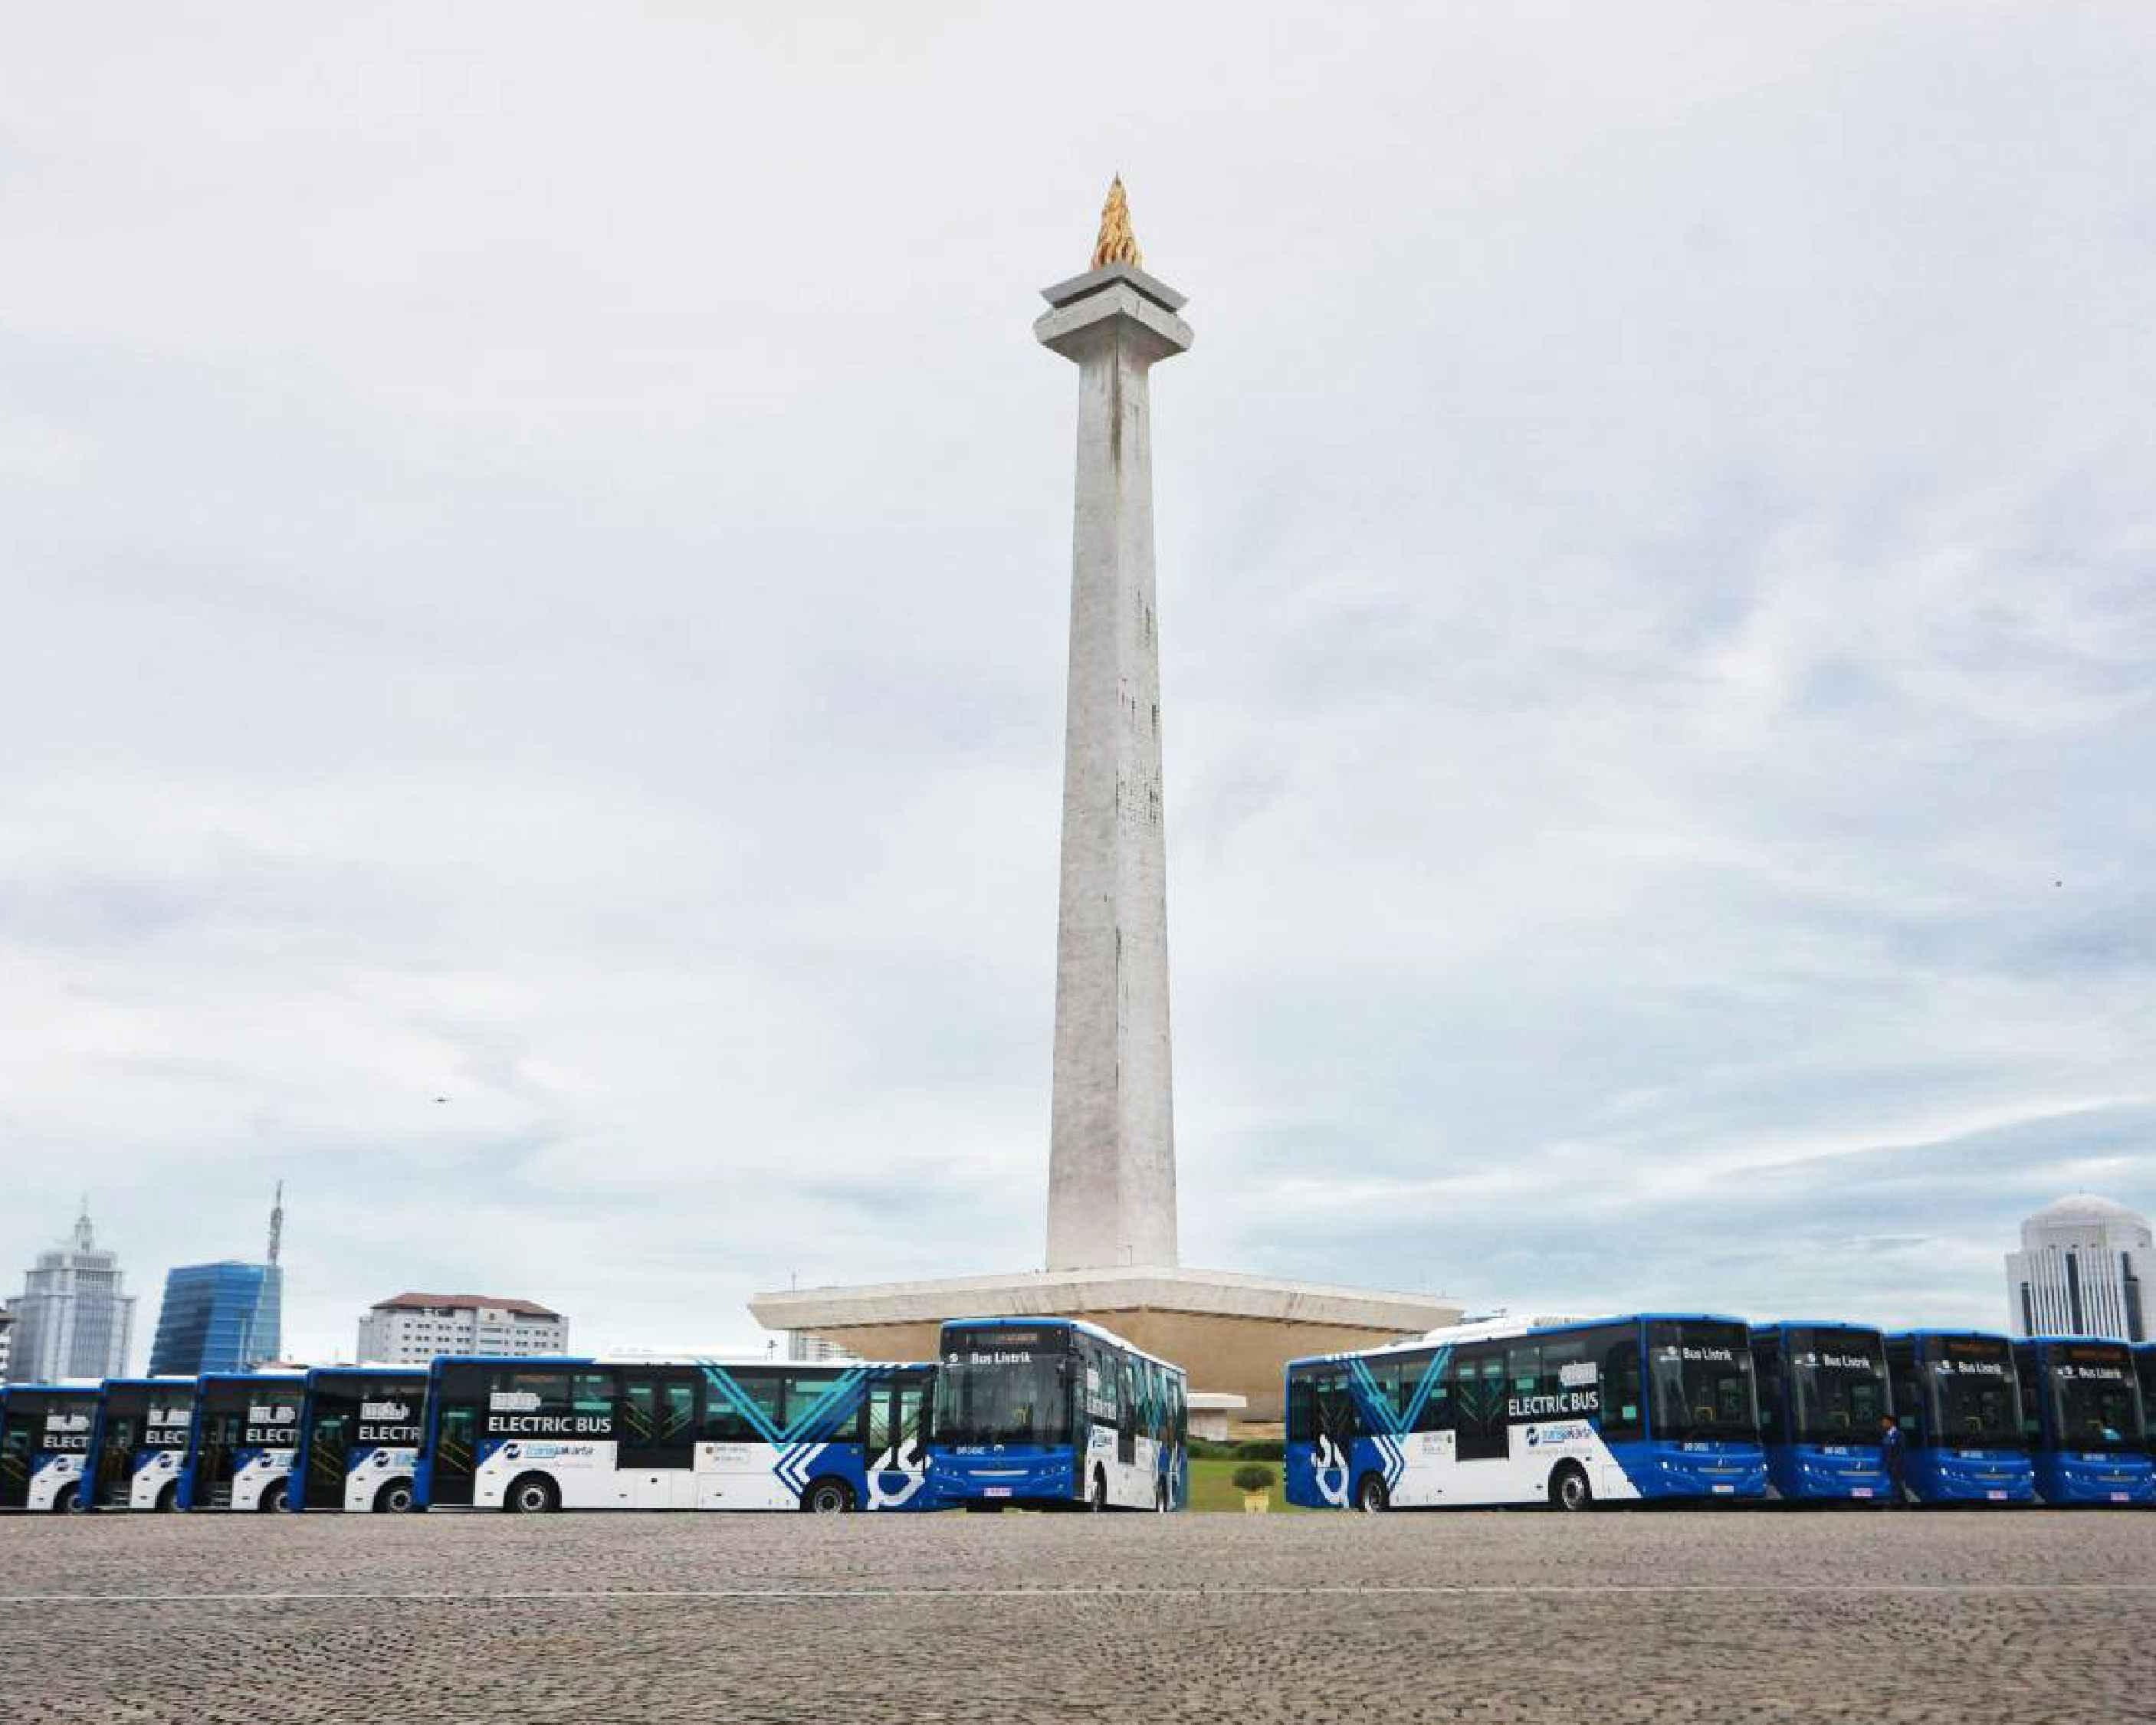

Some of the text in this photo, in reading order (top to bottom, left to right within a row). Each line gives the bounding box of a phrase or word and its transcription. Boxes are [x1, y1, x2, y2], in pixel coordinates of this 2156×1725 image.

[1508, 1391, 1598, 1416] ELECTRIC BUS
[488, 1416, 612, 1432] ELECTRIC BUS
